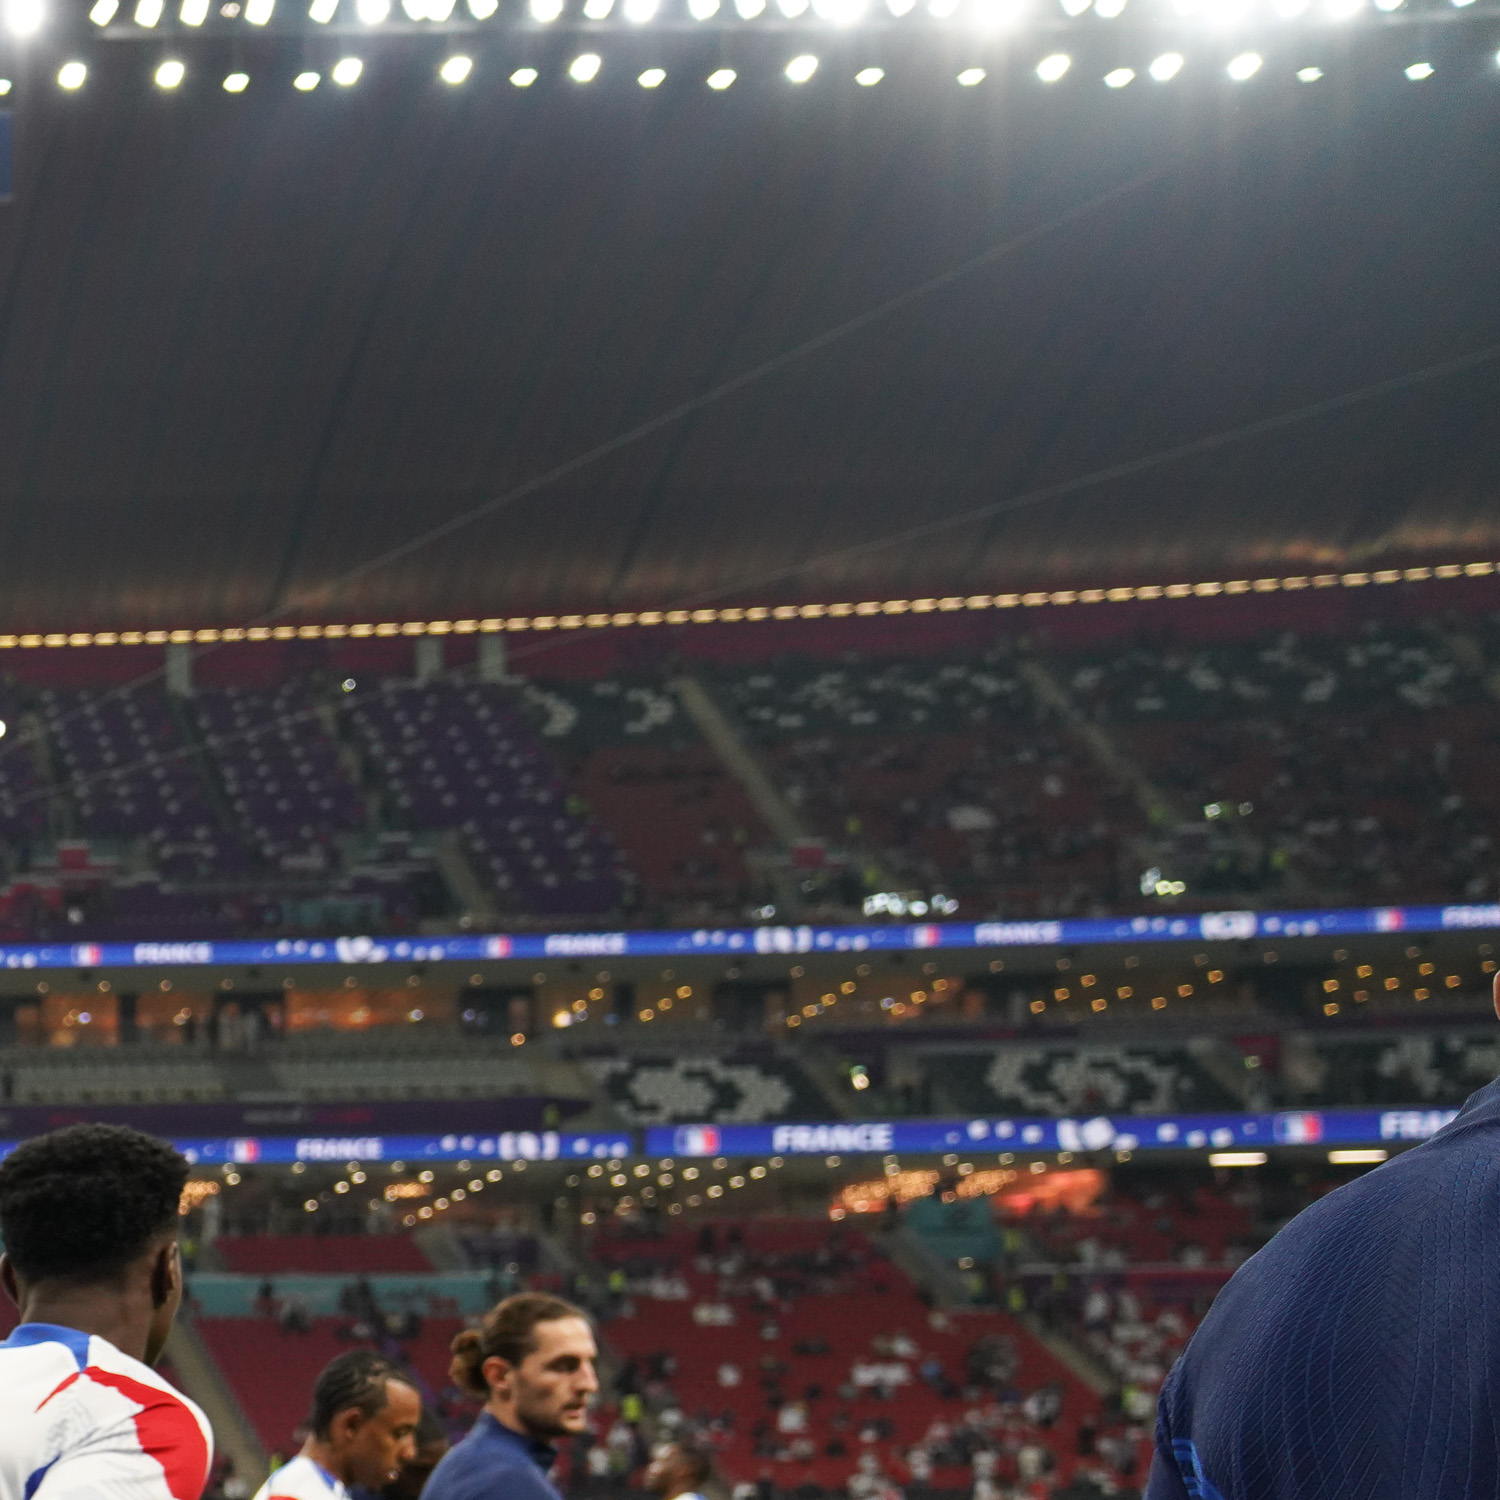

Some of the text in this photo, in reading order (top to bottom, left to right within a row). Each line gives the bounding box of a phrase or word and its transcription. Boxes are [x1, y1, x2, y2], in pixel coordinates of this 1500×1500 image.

[544, 933, 628, 956] FRANCE
[974, 921, 1062, 945] FRANCE
[133, 942, 214, 964] FRANCE
[295, 1137, 383, 1161] FRANCE
[773, 1123, 894, 1153] FRANCE
